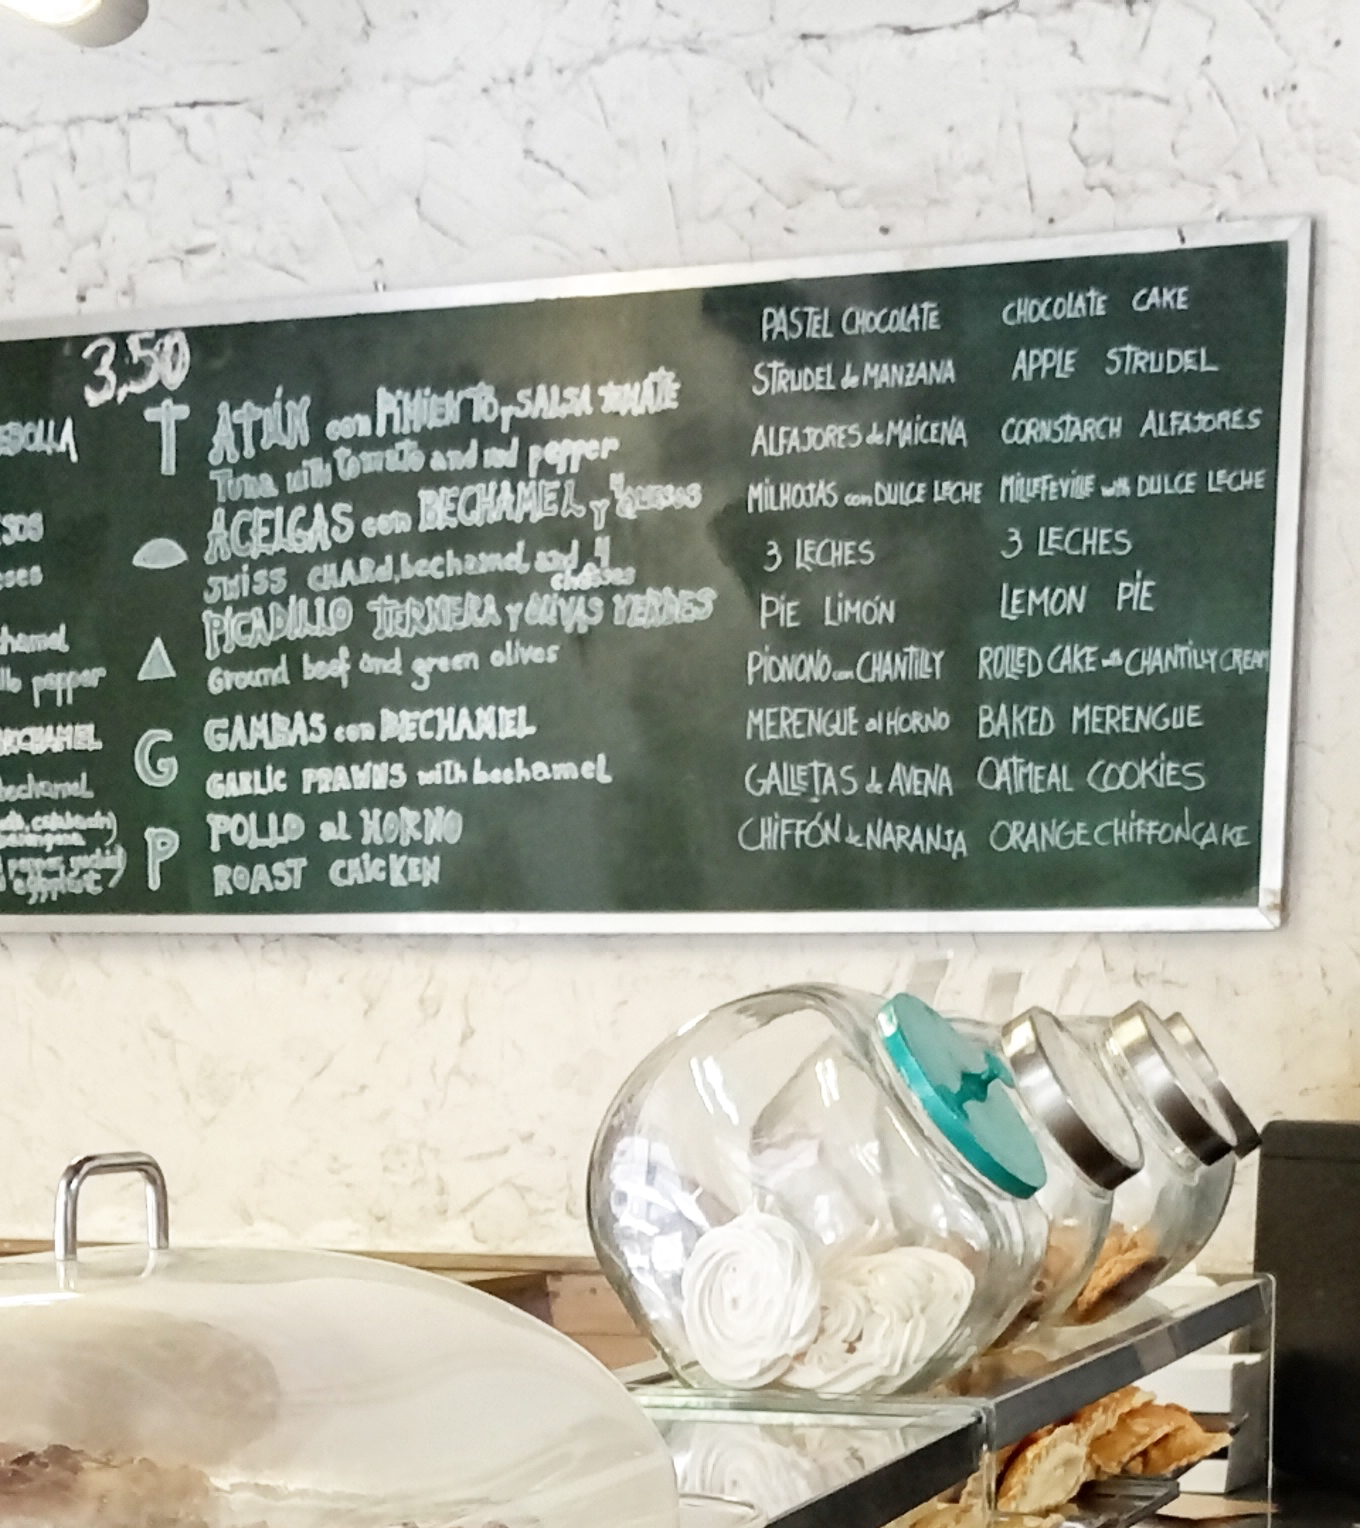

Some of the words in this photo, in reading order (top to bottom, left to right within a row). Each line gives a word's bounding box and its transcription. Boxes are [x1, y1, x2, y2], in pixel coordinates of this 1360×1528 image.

[761, 306, 833, 342] PASTEL
[841, 301, 941, 335] CHOCOLATE
[1002, 286, 1109, 326] CHOCOLATE
[1132, 286, 1189, 313] CAKE
[752, 360, 835, 396] STRUDEL
[862, 360, 956, 389] MANZANA
[1011, 347, 1078, 381] APPLE
[1105, 343, 1219, 378] STRUDEL
[208, 384, 311, 466] ATÚN
[326, 413, 372, 441] con
[515, 383, 594, 419] SALSA
[750, 421, 863, 457] ALFAJORES
[1001, 413, 1122, 446] CORNSTARCH
[1139, 407, 1264, 438] ALFAJORES
[529, 437, 620, 478] pepper
[747, 477, 838, 514] MILHOJAS
[844, 492, 873, 506] con
[874, 481, 928, 507] DULCE
[933, 479, 983, 505] LECHE
[1137, 472, 1198, 497] DULCE
[1207, 469, 1266, 493] LECHE
[204, 502, 355, 565] ACELGAS
[361, 509, 412, 538] con
[418, 478, 586, 532] BECHAMEL
[764, 540, 781, 572] 3
[795, 538, 875, 572] LECHES
[1001, 528, 1023, 559] 3
[1037, 525, 1133, 557] LECHES
[760, 594, 801, 629] PIE
[1000, 582, 1087, 621] LEMON
[1116, 570, 1157, 613] PIE
[202, 594, 353, 660] PICADILLO
[208, 653, 290, 694] Ground
[359, 647, 403, 676] and
[411, 652, 480, 691] green
[490, 639, 560, 667] olives
[747, 644, 832, 686] PIONONO
[856, 644, 945, 683] CHANTILLY
[979, 645, 1043, 680] ROLLED
[1047, 643, 1099, 674] CAKE
[1124, 640, 1218, 676] CHANTILLY
[1219, 647, 1269, 675] CREAM
[203, 710, 327, 752] GAMBAS
[334, 722, 375, 742] con
[380, 705, 537, 743] BECHAMEL
[746, 706, 859, 741] MERENGUE
[886, 706, 950, 736] HORNO
[979, 703, 1056, 739] BAKED
[1072, 703, 1204, 735] MERENGUE
[134, 728, 178, 787] G
[302, 761, 407, 794] PRAWNS
[417, 760, 467, 785] with
[977, 755, 1074, 795] OATMEAL
[1086, 750, 1206, 793] COOKIES
[745, 759, 859, 797] GALLETAS
[888, 762, 953, 797] AVENA
[206, 811, 305, 852] POLLO
[319, 810, 352, 842] al
[359, 806, 463, 847] HORNO
[866, 818, 969, 859] NARANJA
[990, 819, 1092, 852] ORANGE
[144, 826, 179, 891] P
[213, 856, 308, 897] ROAST
[328, 852, 440, 887] CHICKEN
